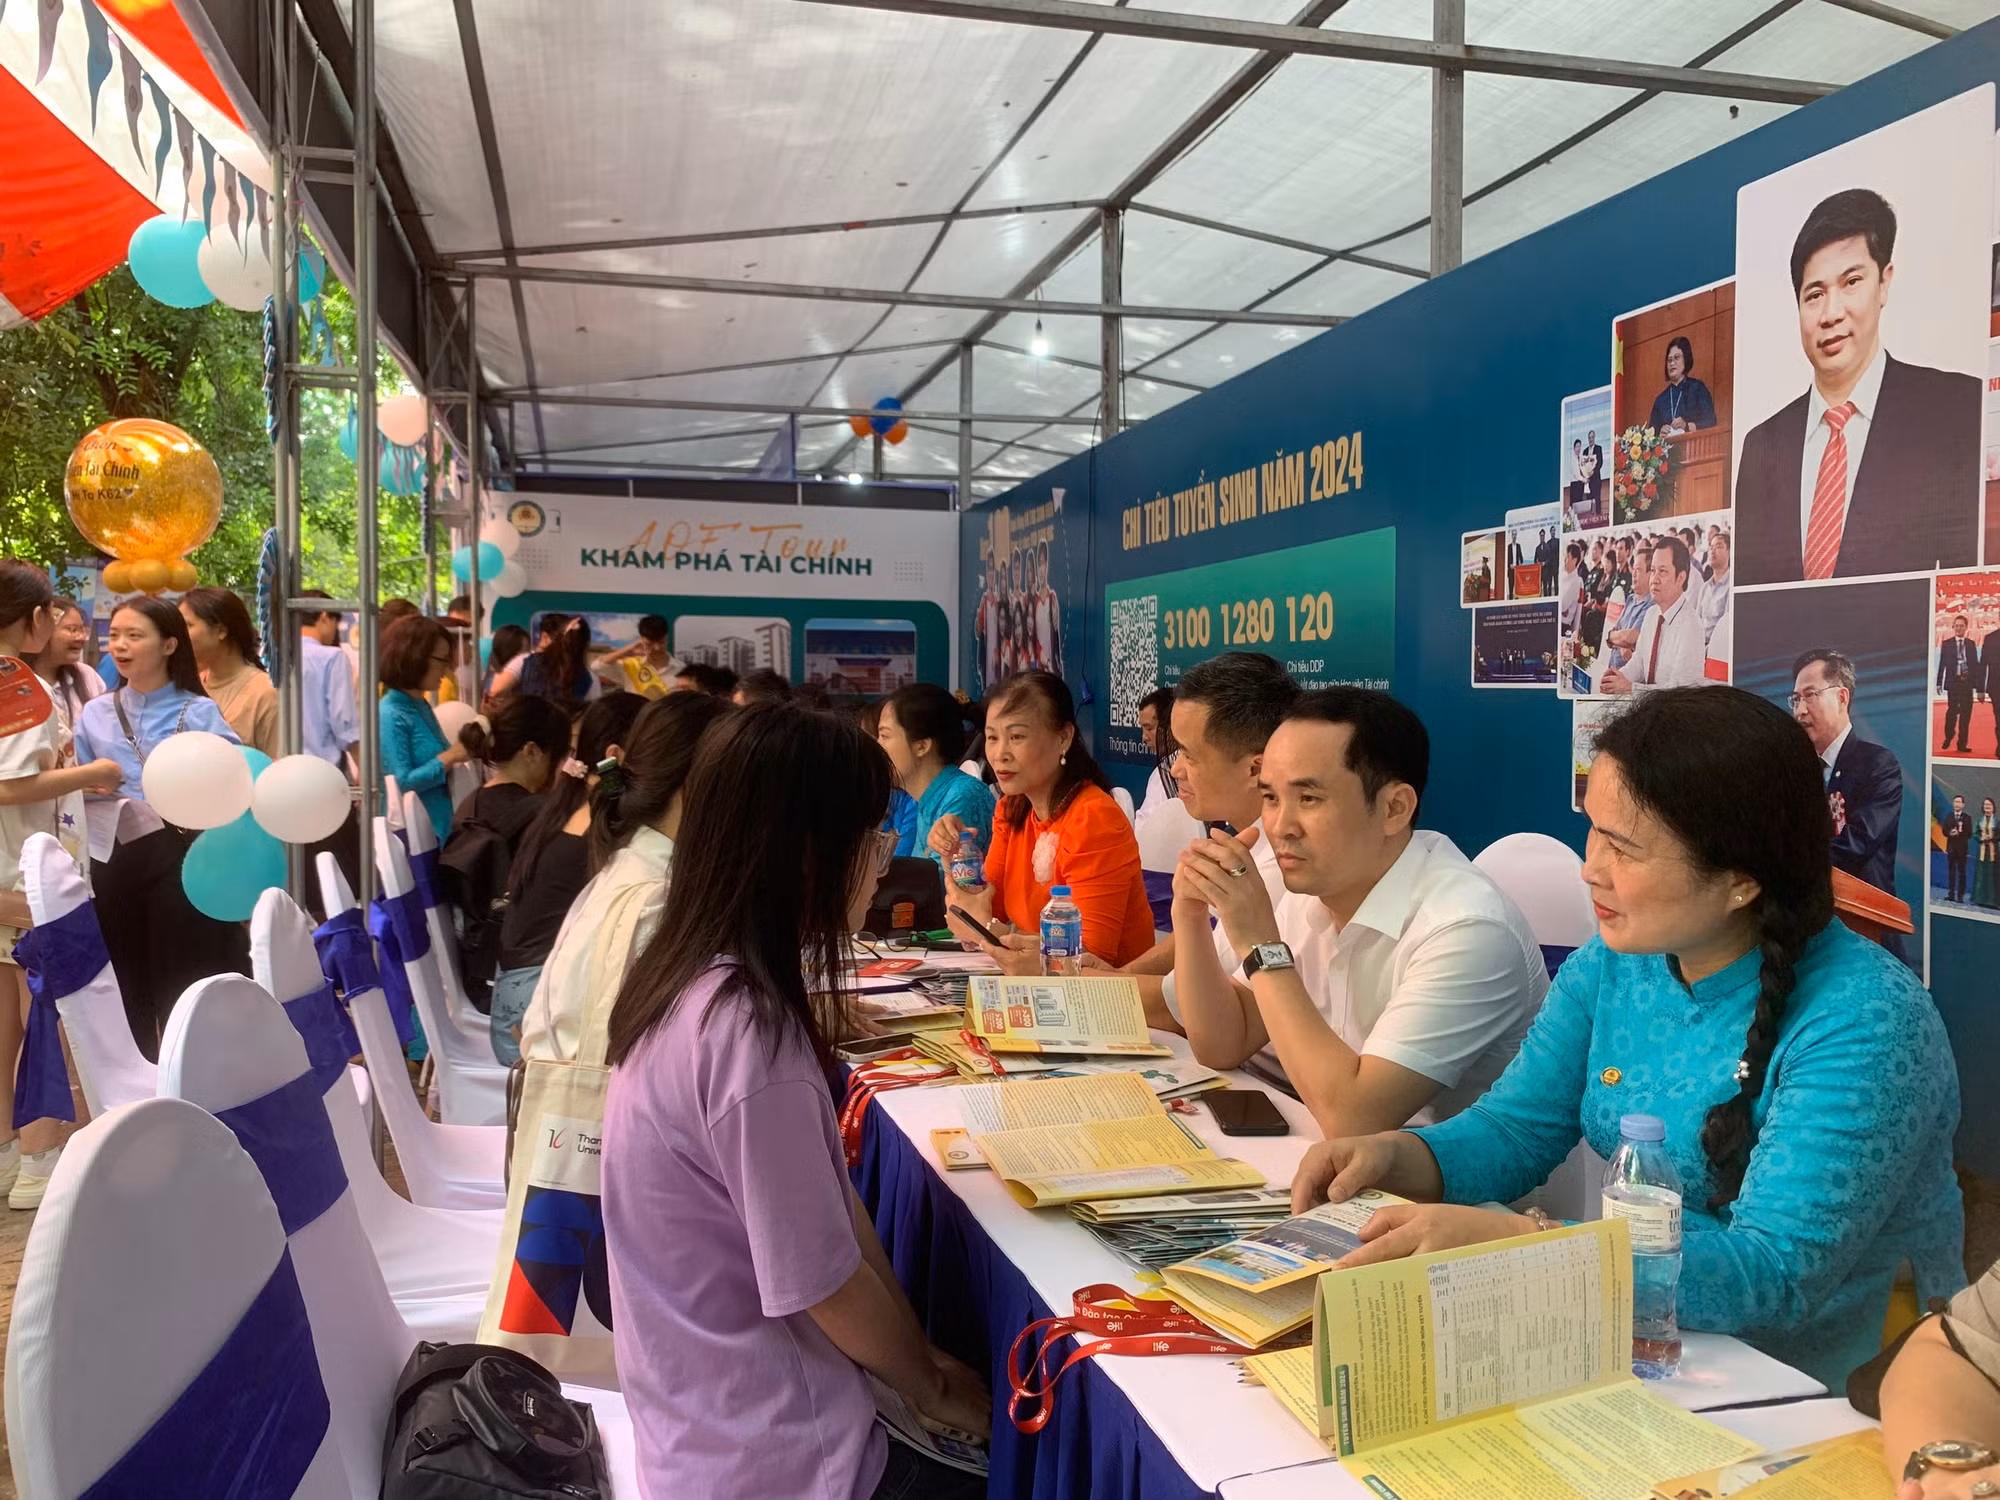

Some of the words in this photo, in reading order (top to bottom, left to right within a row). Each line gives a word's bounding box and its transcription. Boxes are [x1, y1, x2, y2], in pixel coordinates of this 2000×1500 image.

[97, 487, 123, 500] K62
[1121, 497, 1142, 551] CHỈ
[1144, 491, 1170, 546] TIÊU
[1172, 469, 1216, 539] TUYỂN
[1219, 467, 1257, 527] SINH
[1261, 447, 1305, 515] NĂM
[1310, 431, 1364, 502] 2024
[580, 544, 666, 570] KHÁM
[674, 547, 733, 572] PHÁ
[739, 549, 782, 574] TÀI
[789, 551, 872, 576] CHÍNH
[748, 523, 849, 561] Tour
[1164, 606, 1211, 650] 3100
[1220, 596, 1275, 646] 1280
[1286, 590, 1334, 642] 120
[1309, 659, 1325, 673] DDP
[1108, 736, 1128, 756] Thông
